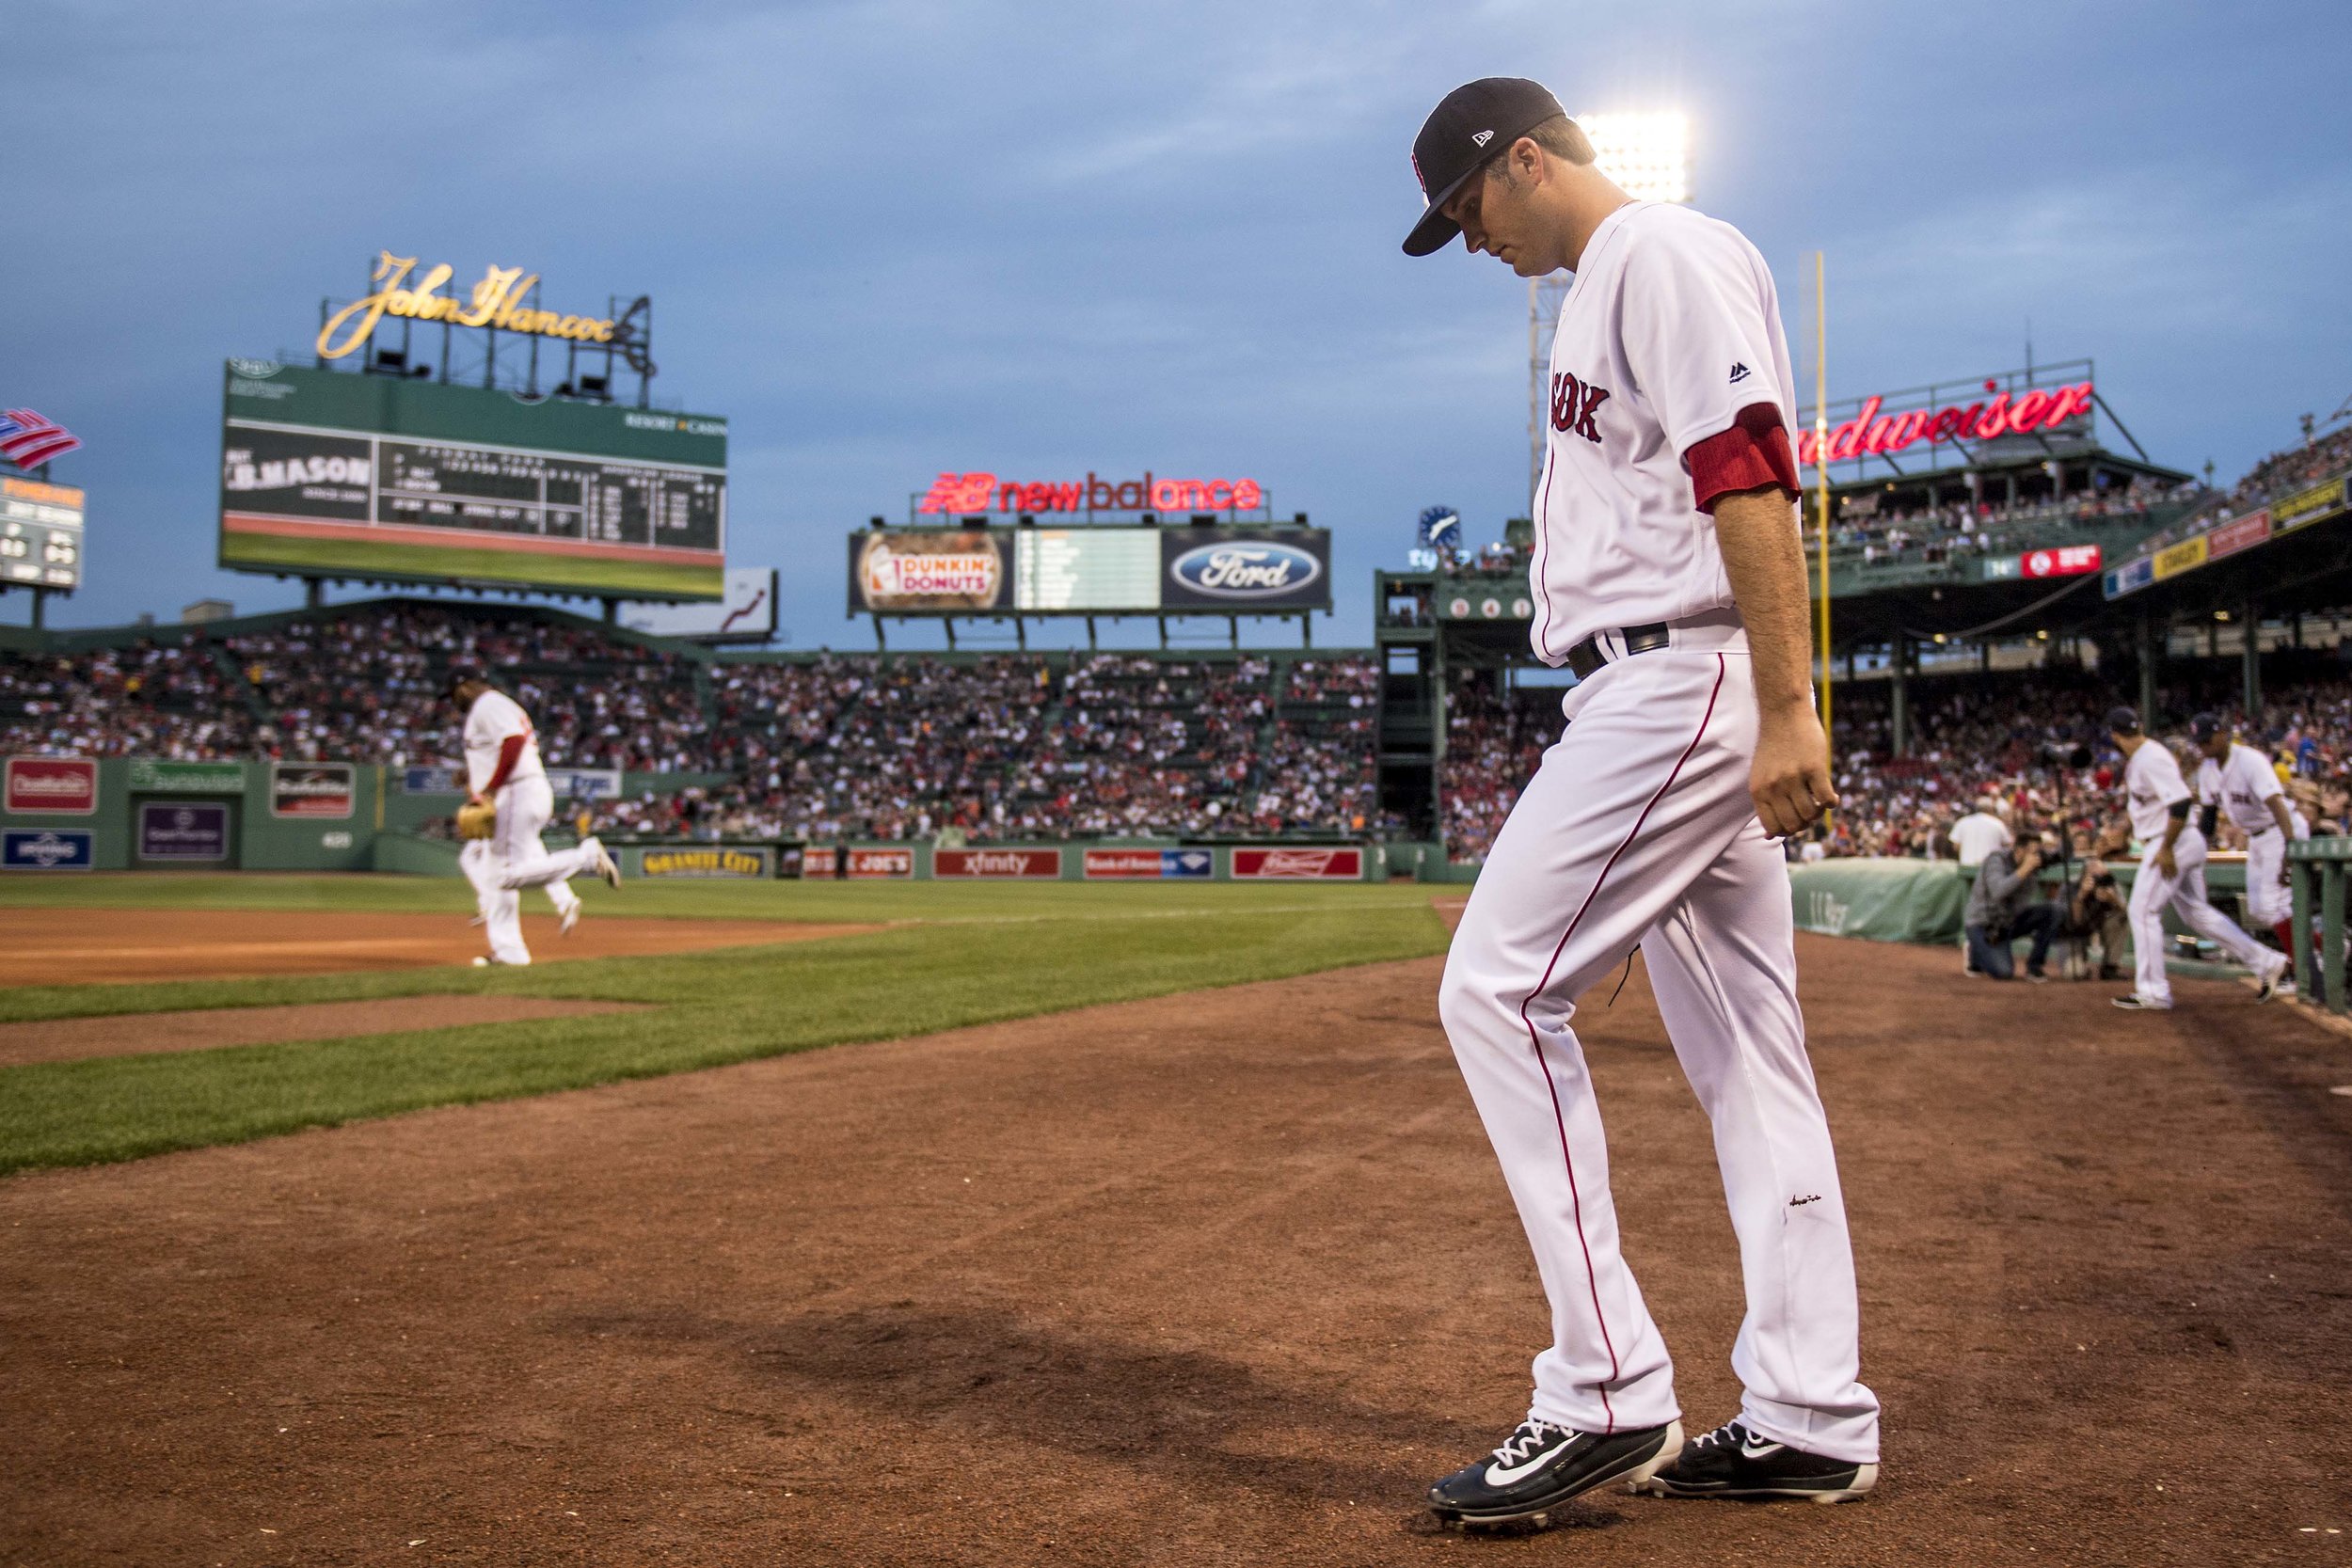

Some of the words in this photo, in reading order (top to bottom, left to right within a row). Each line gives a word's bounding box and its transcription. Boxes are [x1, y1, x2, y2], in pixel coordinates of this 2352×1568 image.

[316, 249, 464, 360] John
[1798, 380, 2093, 464] udweiser
[903, 576, 986, 590] DONUTS
[1200, 548, 1292, 587] Ford
[964, 852, 1030, 875] xfinity
